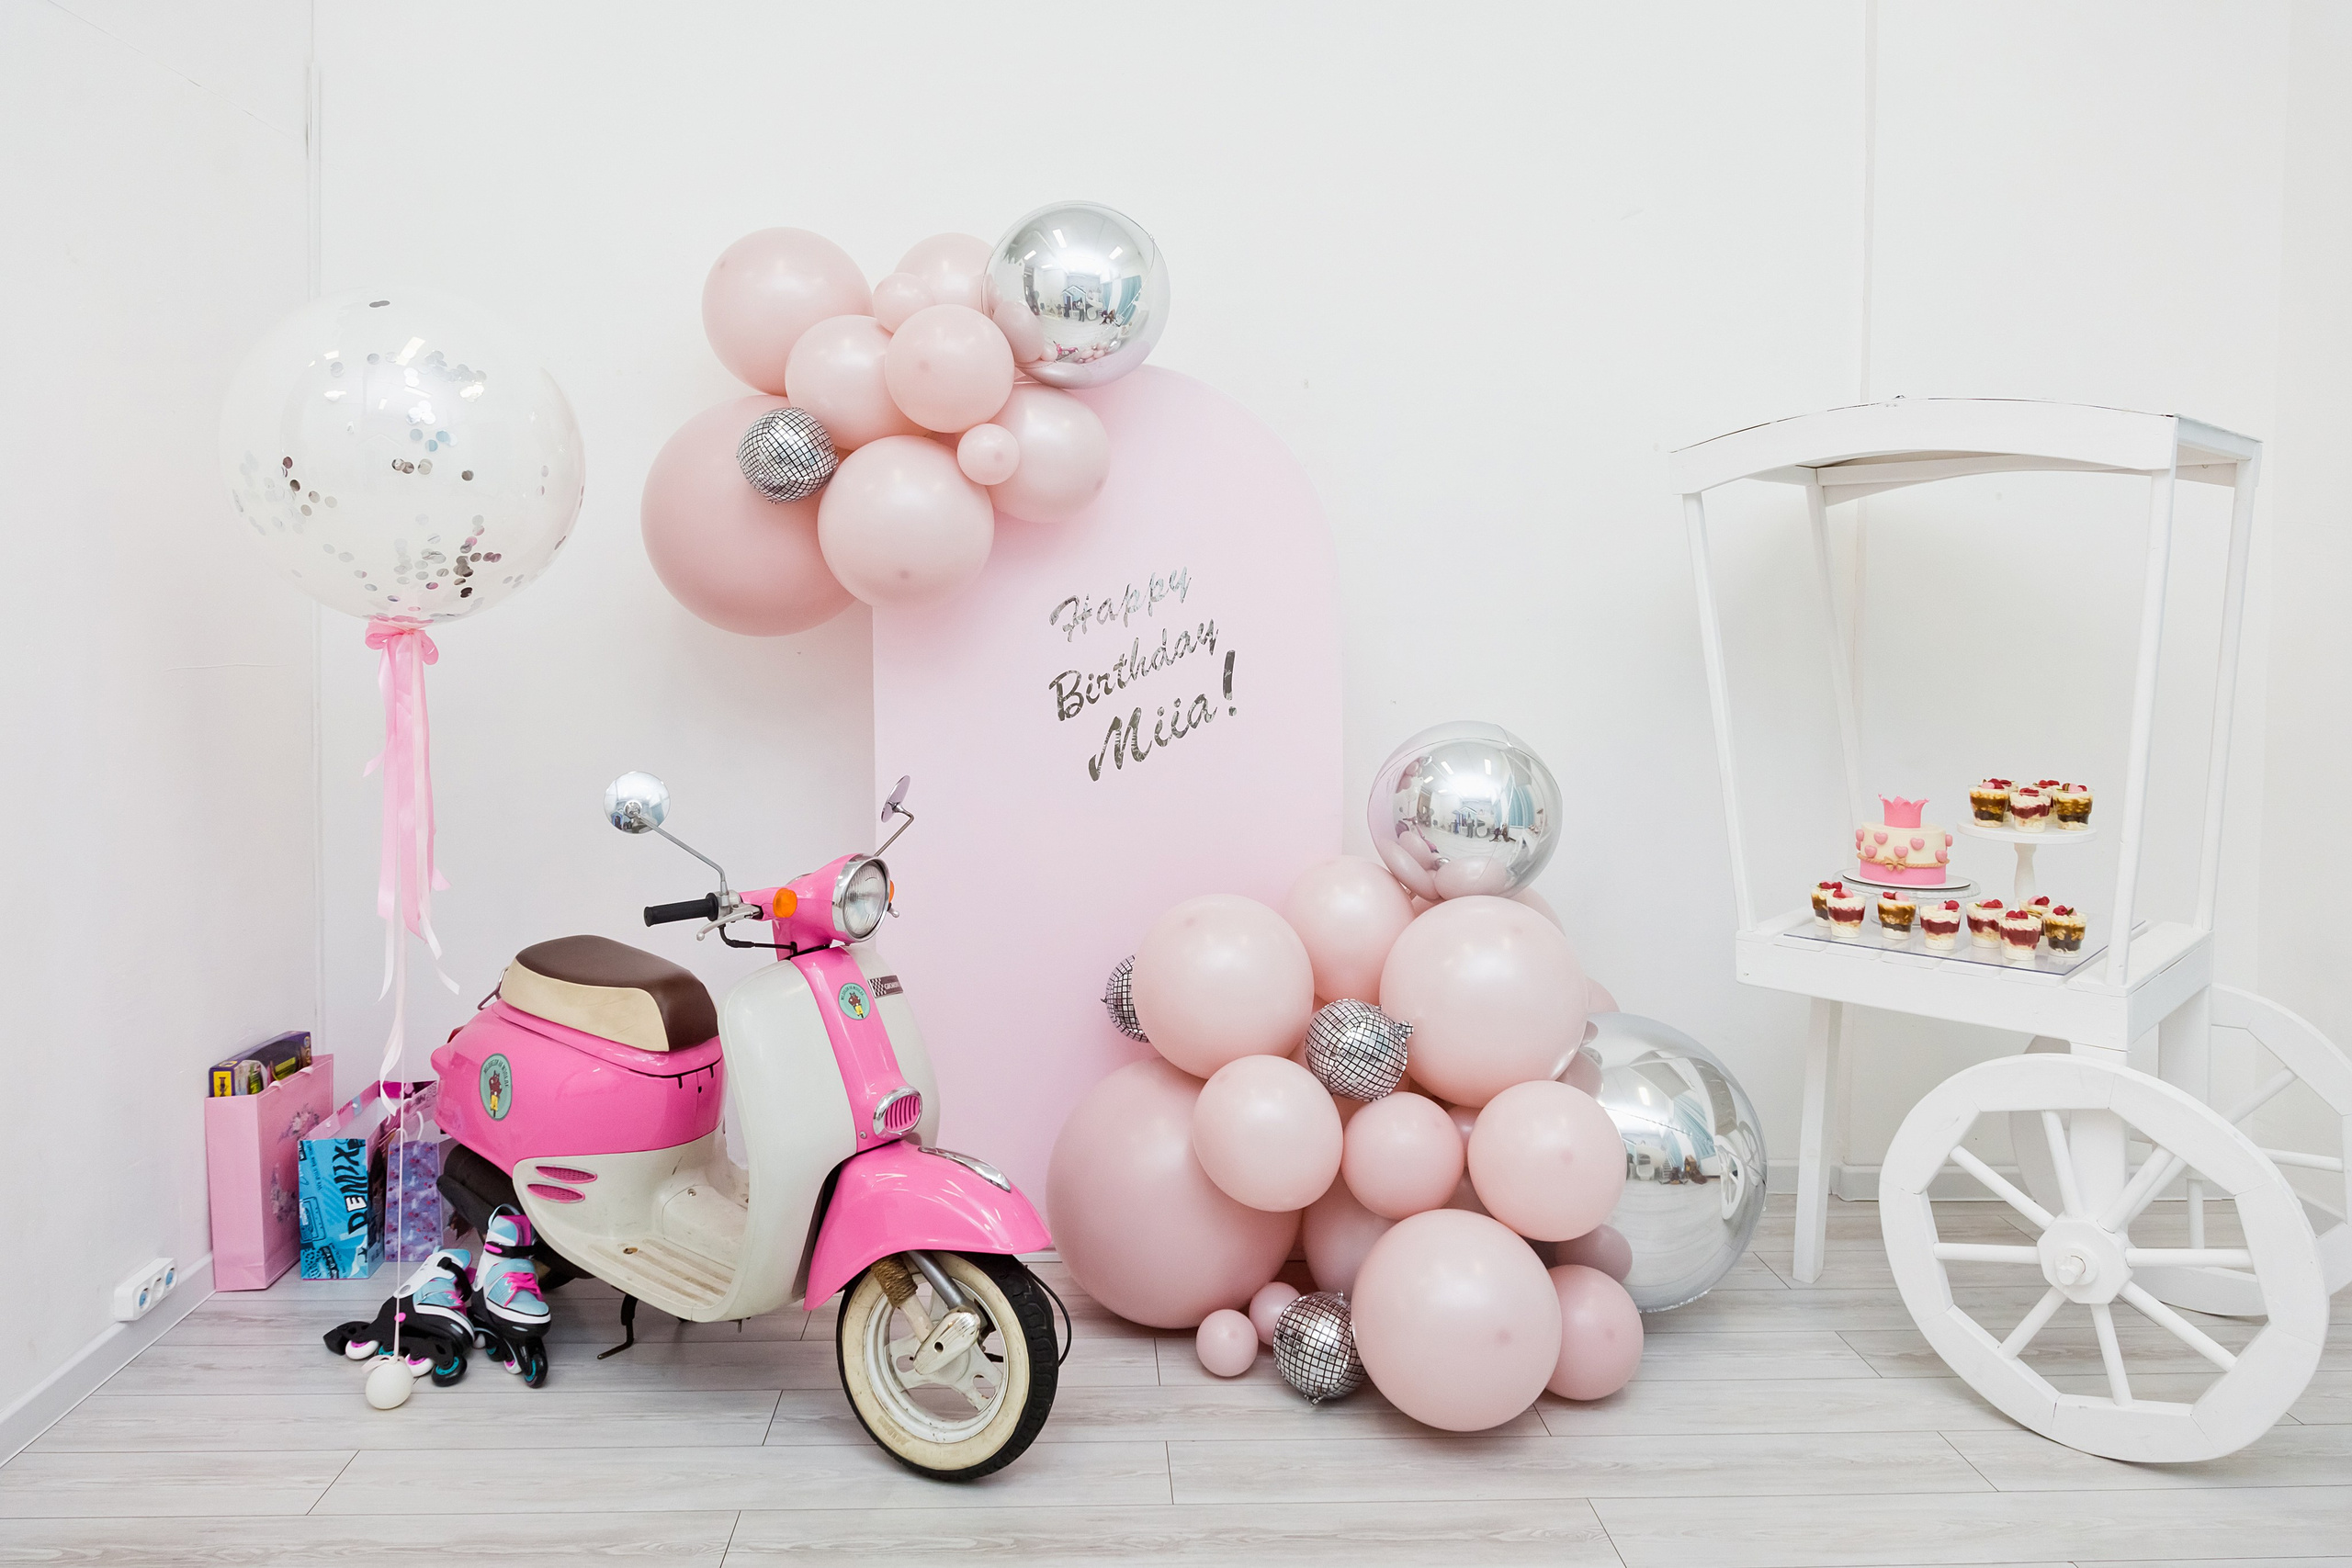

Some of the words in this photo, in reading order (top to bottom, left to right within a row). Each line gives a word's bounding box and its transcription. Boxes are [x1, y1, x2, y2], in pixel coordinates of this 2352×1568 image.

[1049, 566, 1192, 642] Happy
[1049, 619, 1219, 721] Birthday
[1089, 649, 1238, 782] Miia!
